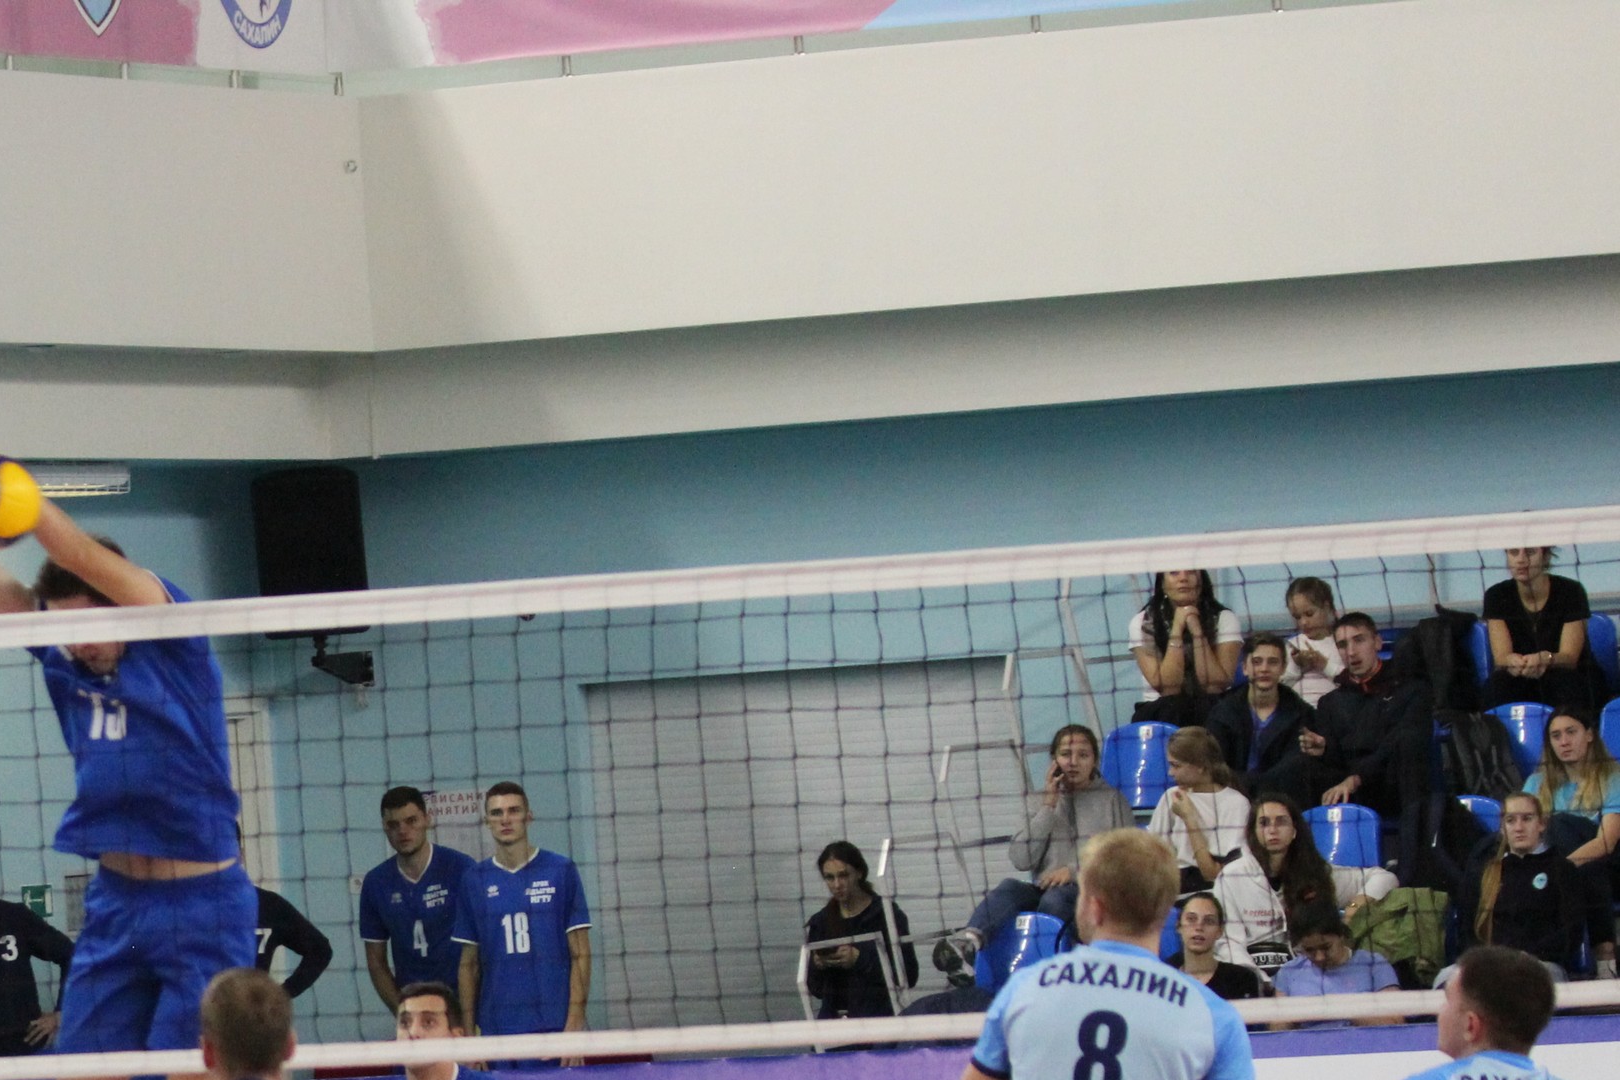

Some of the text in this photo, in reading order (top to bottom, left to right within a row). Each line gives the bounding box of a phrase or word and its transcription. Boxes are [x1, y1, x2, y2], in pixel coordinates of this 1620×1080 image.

[427, 803, 479, 816] АНЯТИЙ
[413, 919, 429, 958] 4
[501, 912, 531, 955] 18
[1039, 962, 1189, 1007] САХАЛИН
